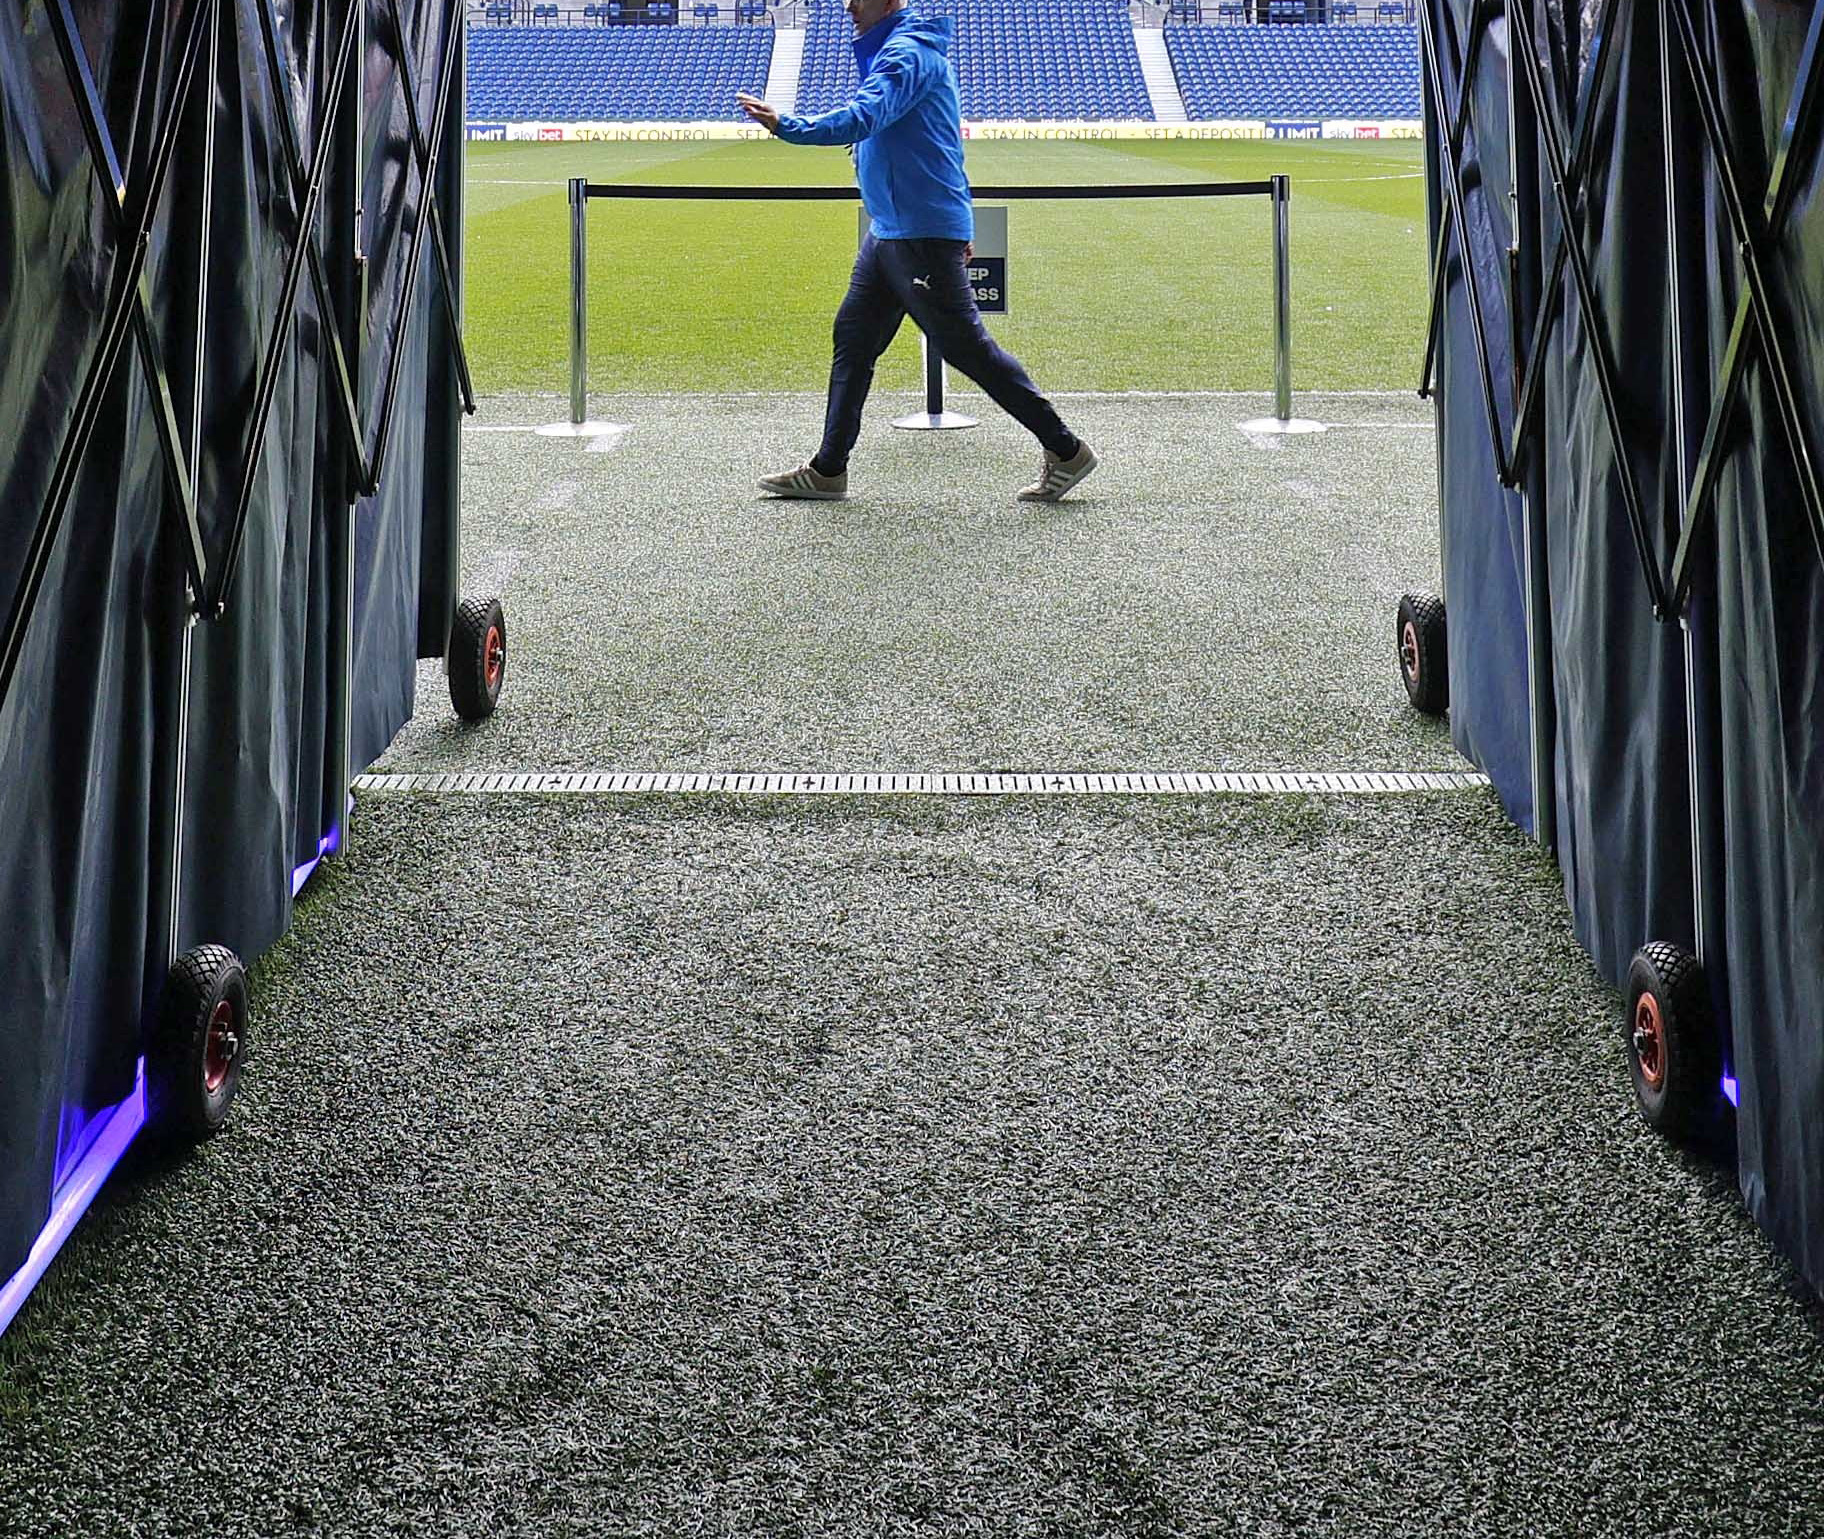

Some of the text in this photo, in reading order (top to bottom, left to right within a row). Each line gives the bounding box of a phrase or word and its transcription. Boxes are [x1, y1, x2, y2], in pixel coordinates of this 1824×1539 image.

[539, 128, 561, 141] bet
[575, 130, 610, 141] STAY
[616, 130, 632, 140] IN
[982, 129, 1017, 139] STAY
[1023, 129, 1039, 139] IN
